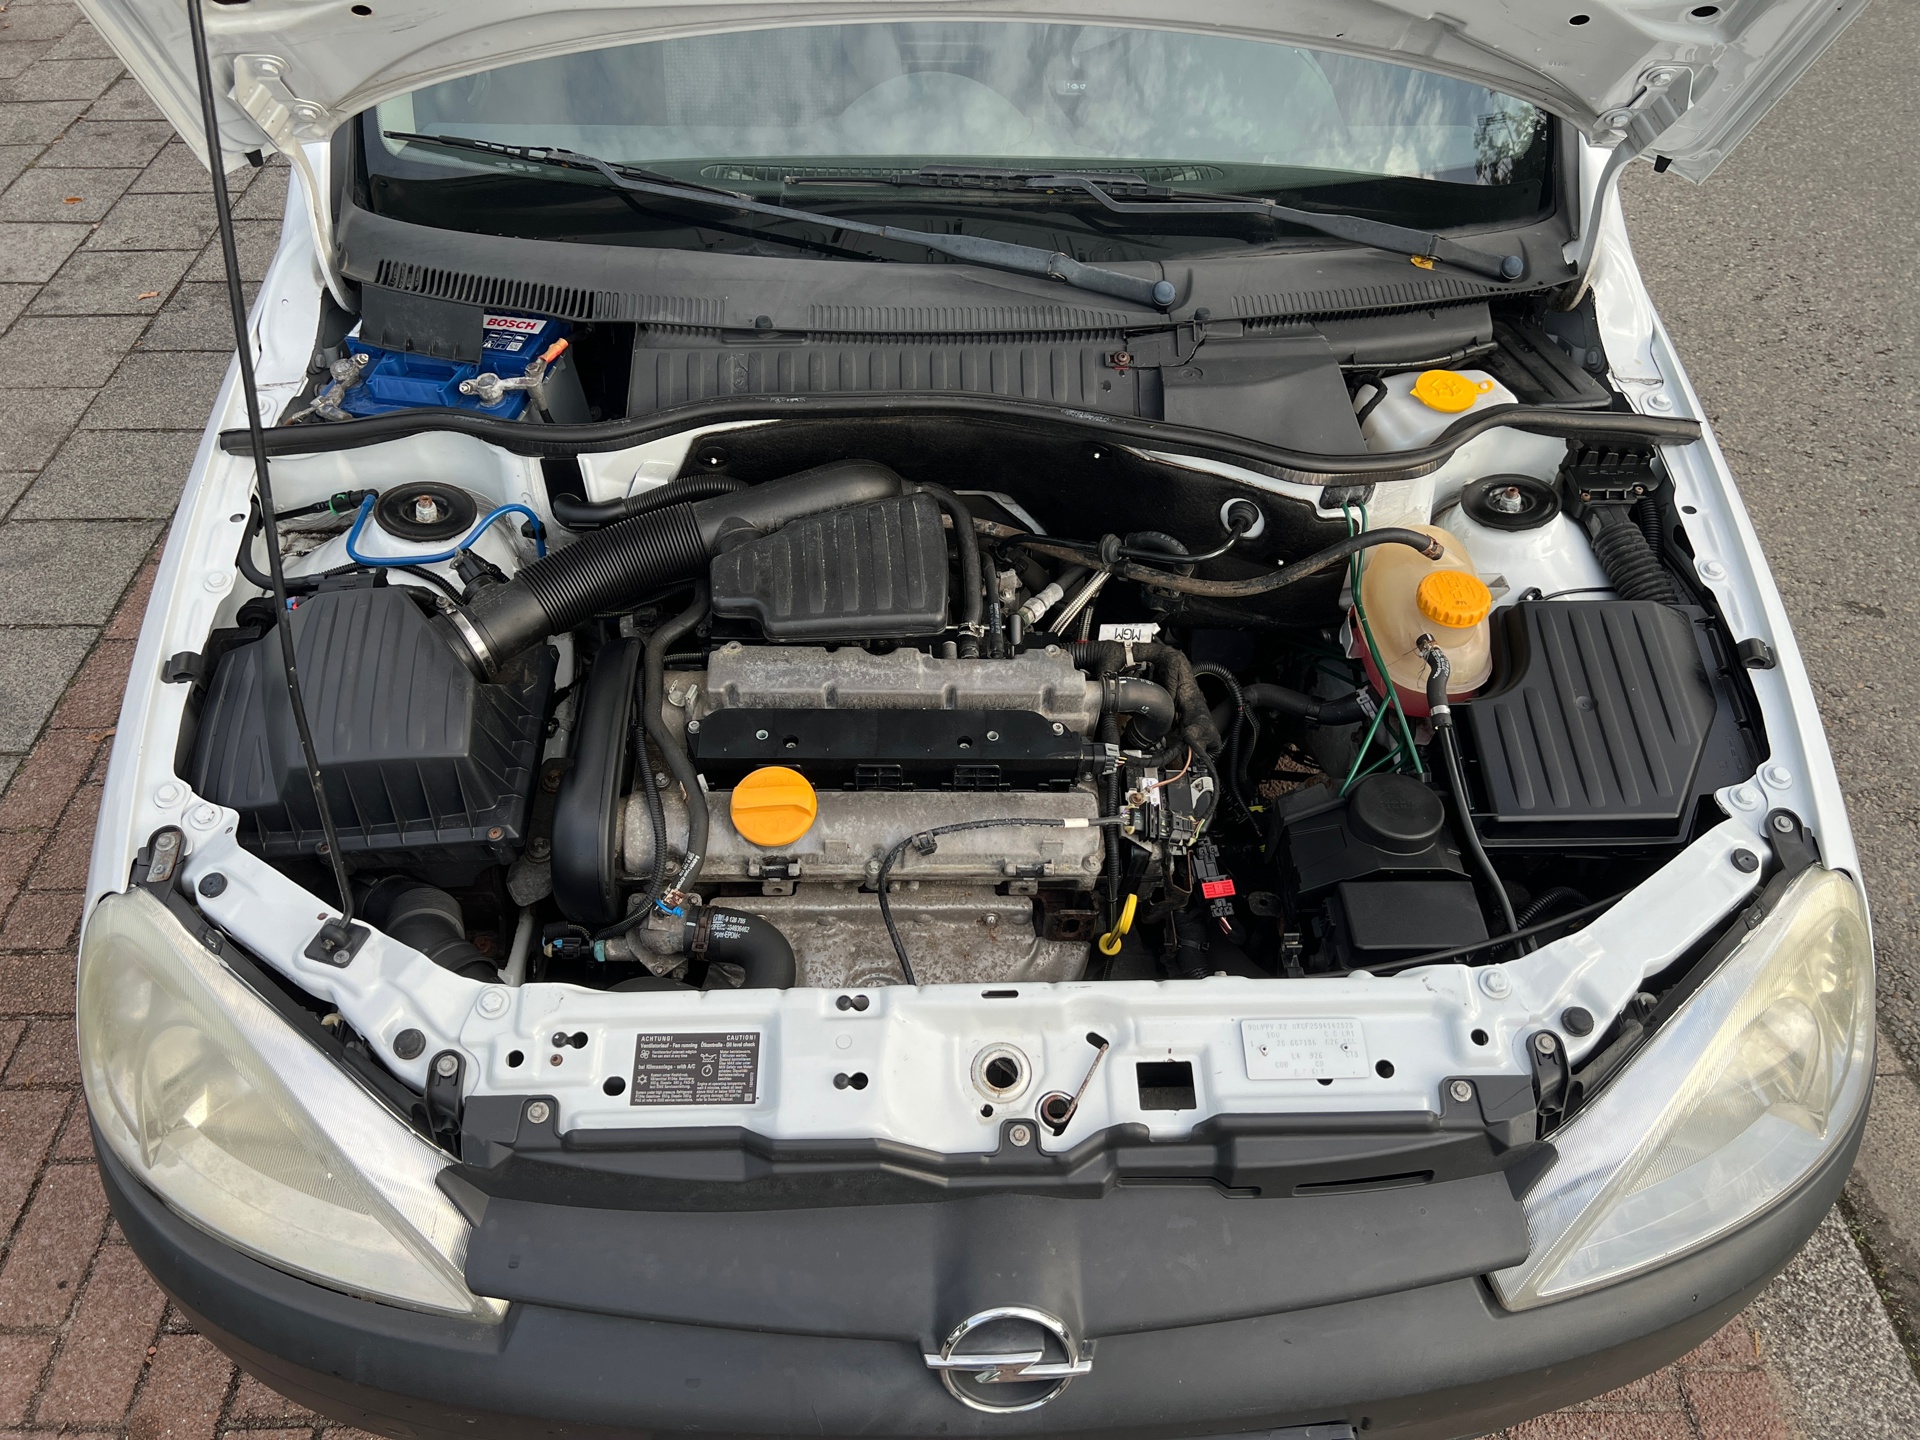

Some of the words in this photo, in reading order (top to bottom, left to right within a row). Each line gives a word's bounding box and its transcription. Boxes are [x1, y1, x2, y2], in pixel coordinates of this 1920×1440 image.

[486, 318, 537, 330] BOSCH
[1115, 627, 1141, 641] MGM
[1309, 1052, 1323, 1060] 926
